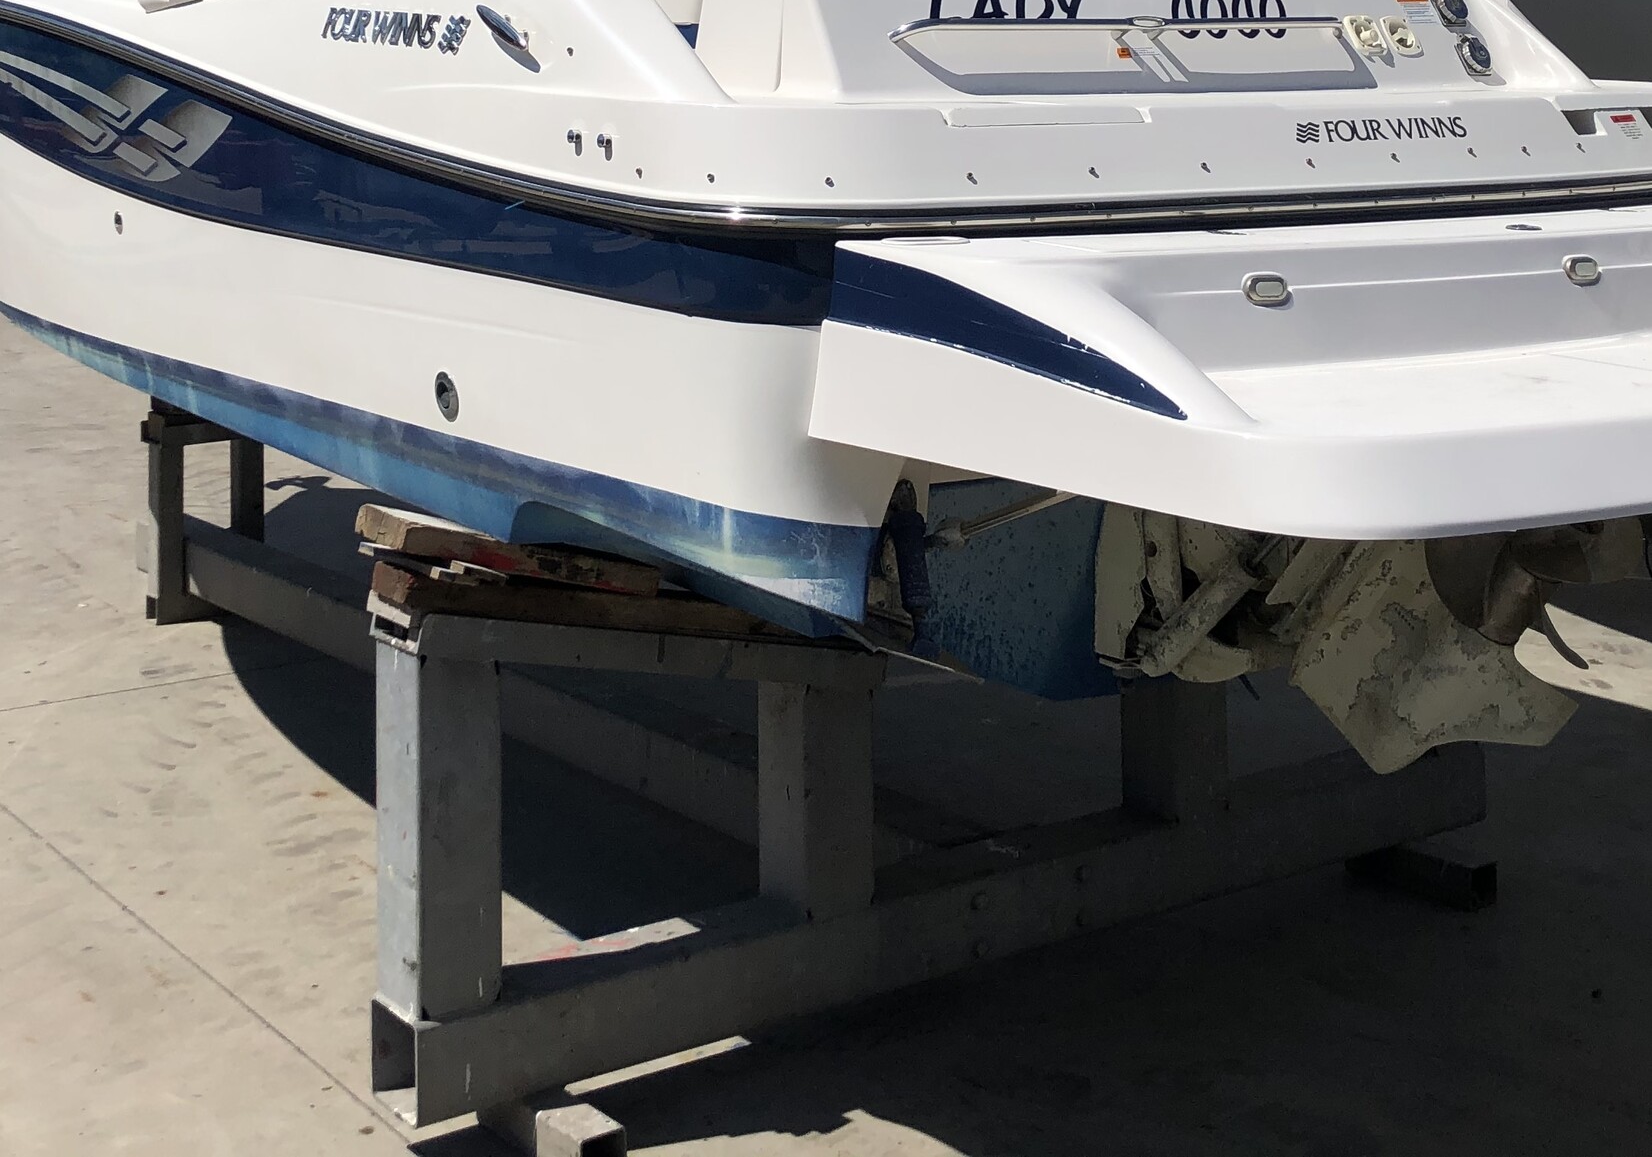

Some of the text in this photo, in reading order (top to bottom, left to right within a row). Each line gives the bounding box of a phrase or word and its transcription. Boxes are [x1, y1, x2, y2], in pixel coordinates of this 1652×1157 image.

[321, 7, 442, 50] FOUR WINNS
[1323, 116, 1468, 143] FOUR WINNS
